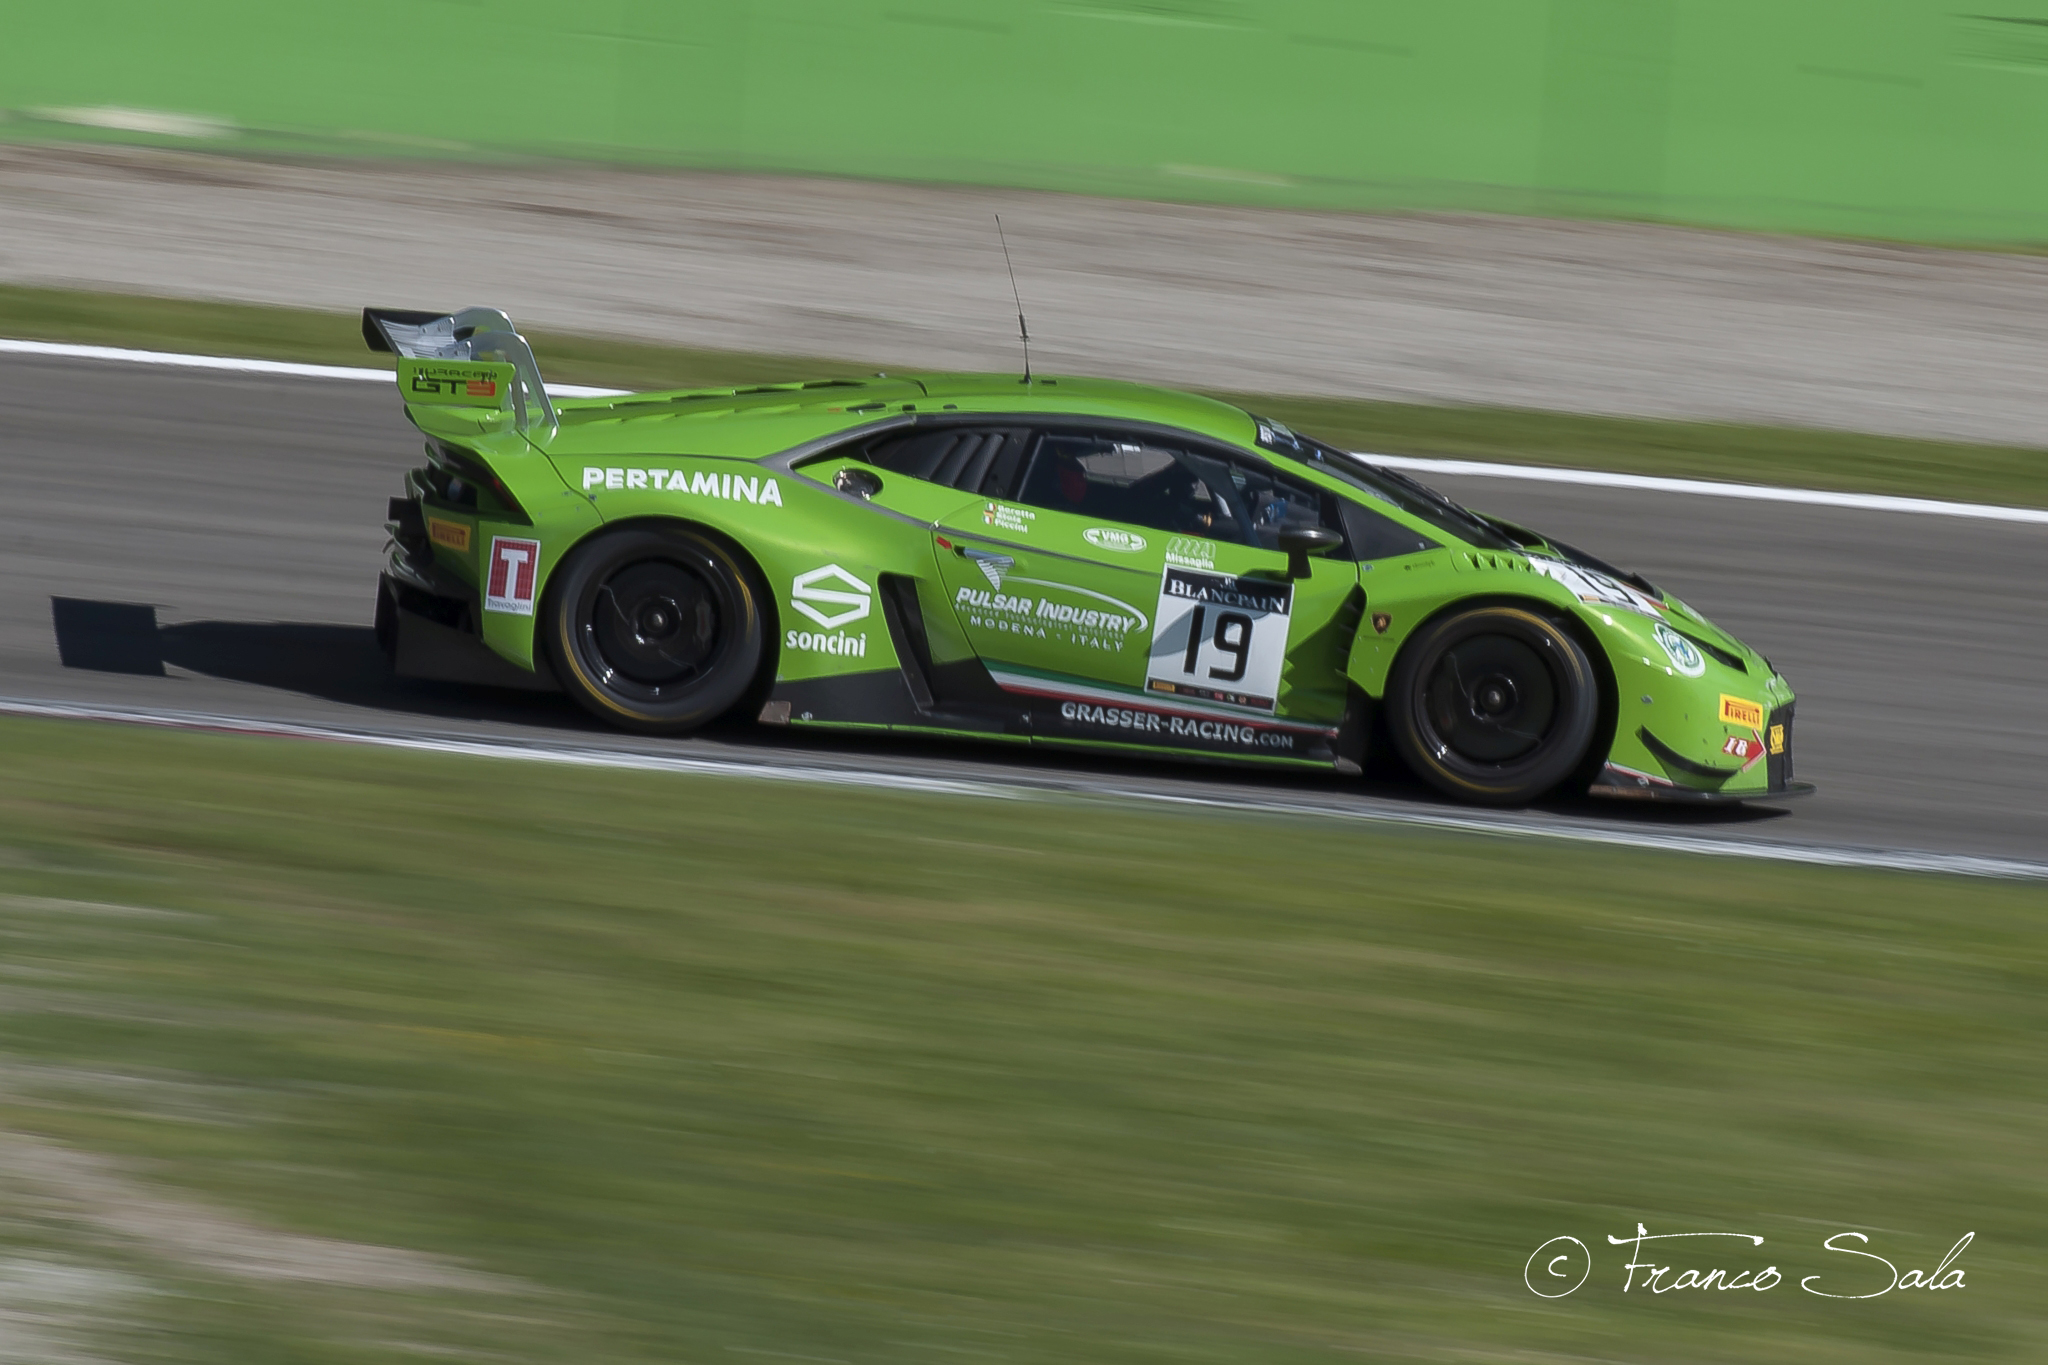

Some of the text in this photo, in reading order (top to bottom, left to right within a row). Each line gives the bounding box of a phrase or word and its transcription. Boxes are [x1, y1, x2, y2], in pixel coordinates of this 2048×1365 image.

[412, 376, 496, 396] GT3
[582, 466, 783, 507] PERTAMINA
[501, 547, 529, 600] T
[955, 587, 1136, 634] PULSAR INDUSTRY
[1169, 578, 1285, 613] BLANCPAIN
[786, 629, 867, 659] soncini
[970, 615, 1125, 653] MODENA ITALY
[1183, 605, 1254, 682] 19
[1061, 701, 1294, 749] GRASSER-RACING.COM
[1724, 699, 1760, 726] PIRELLI
